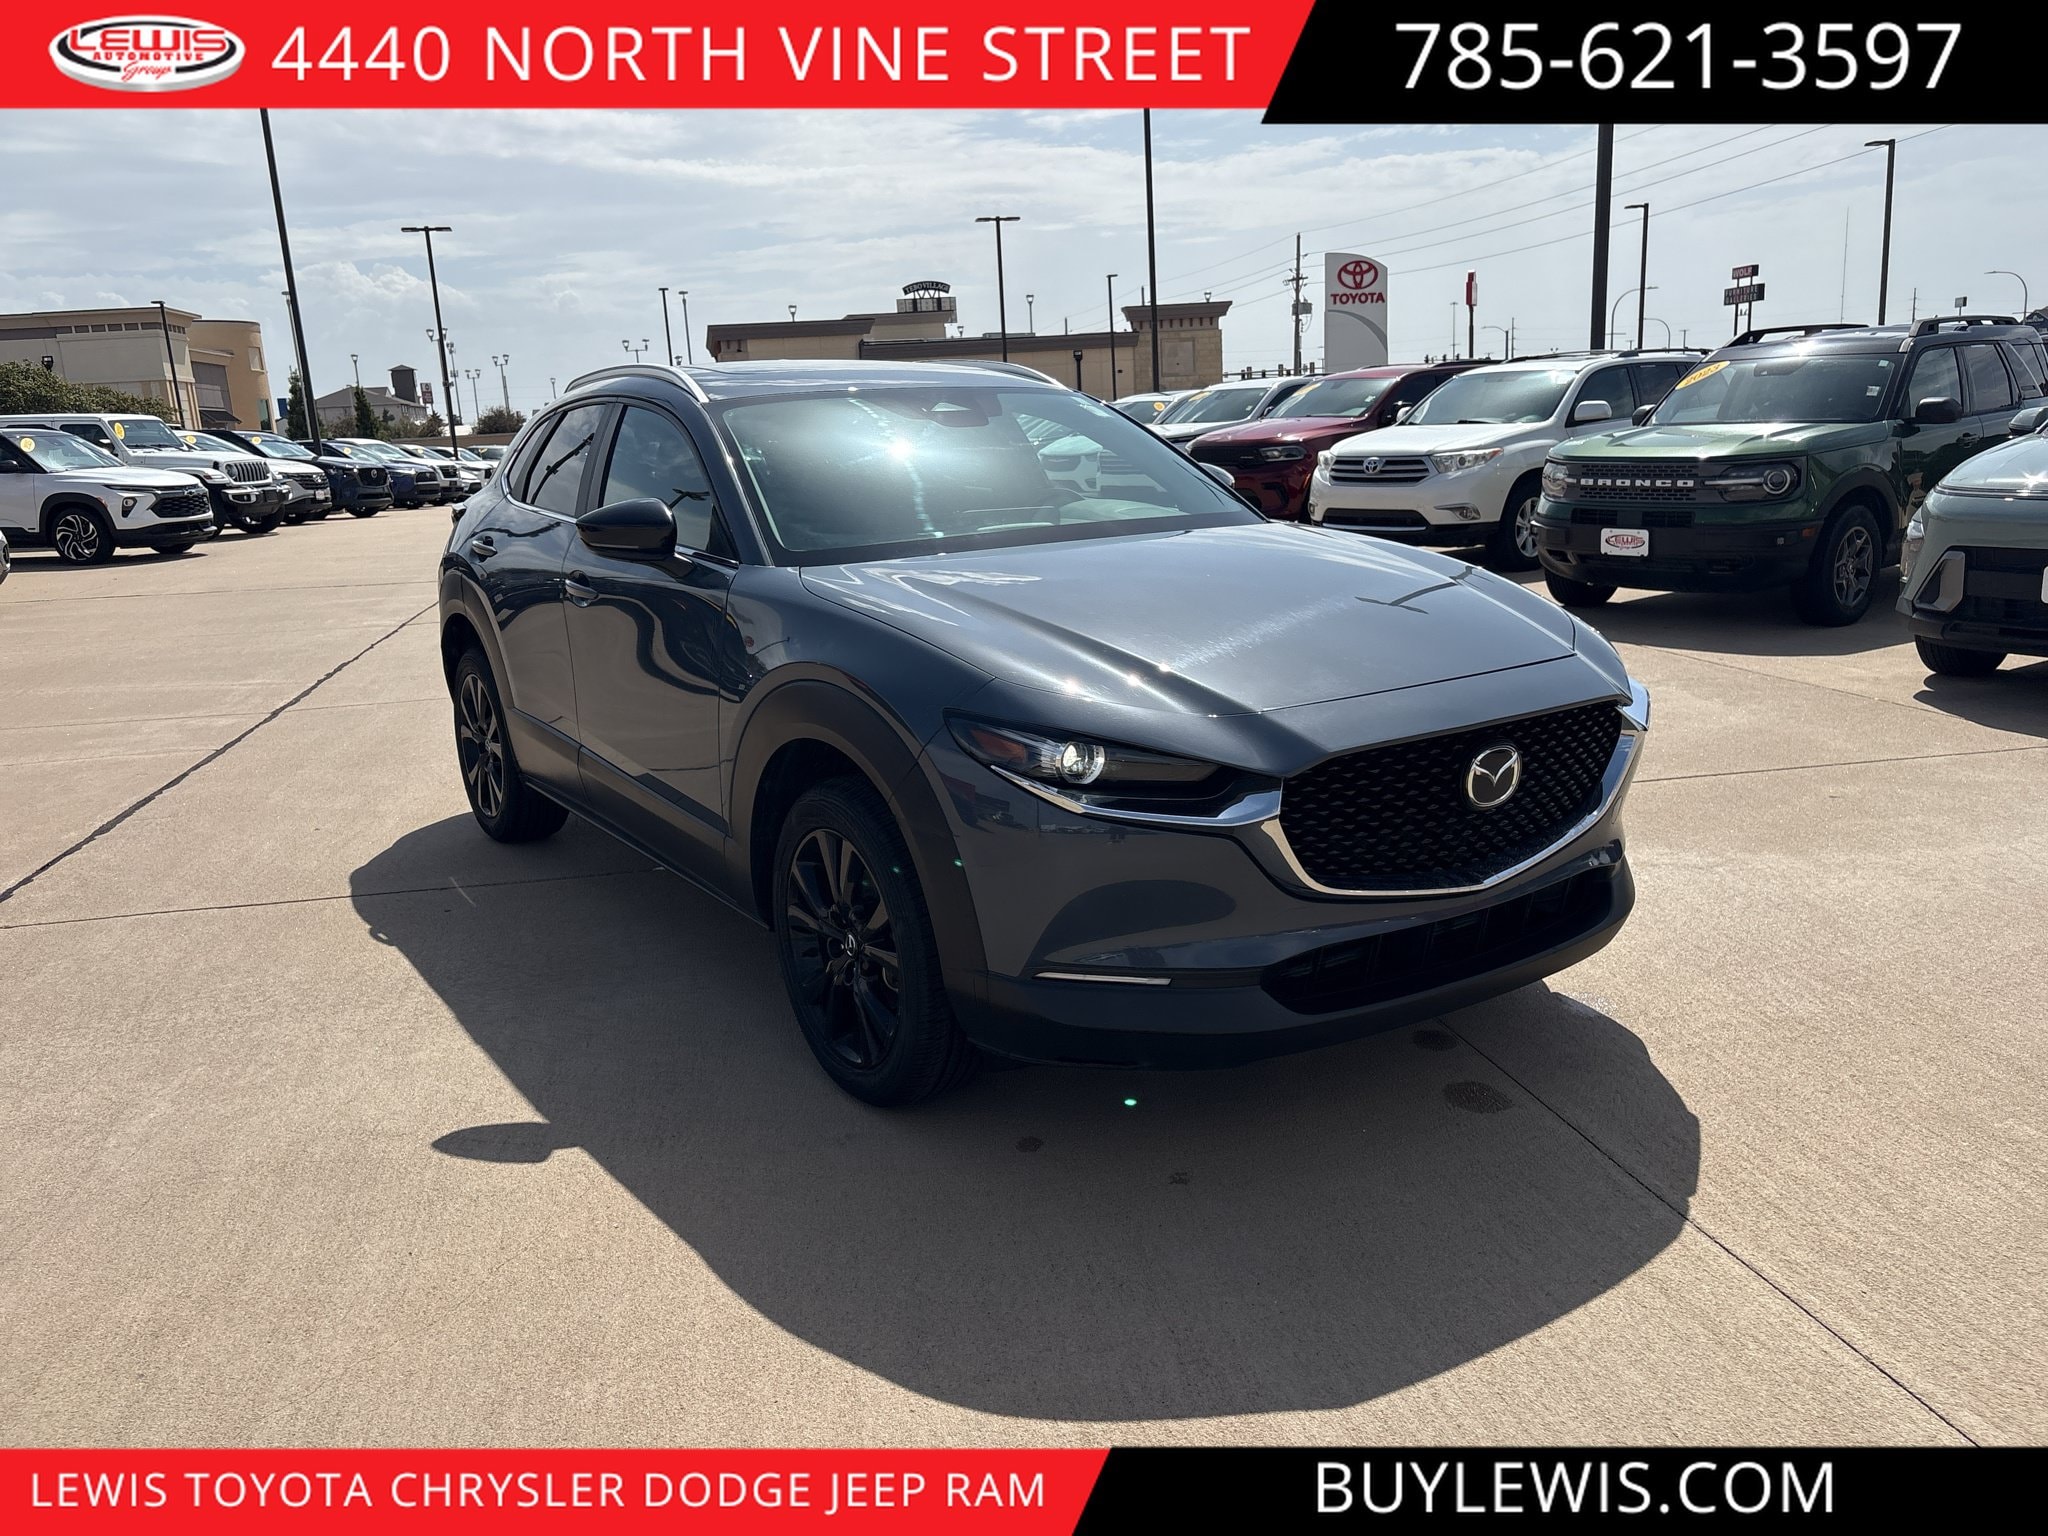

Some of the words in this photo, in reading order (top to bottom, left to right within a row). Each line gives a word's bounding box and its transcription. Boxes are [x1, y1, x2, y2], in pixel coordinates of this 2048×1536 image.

[1733, 267, 1753, 278] WOLF
[1330, 292, 1385, 305] TOYOTA
[1580, 478, 1694, 487] BRONCO
